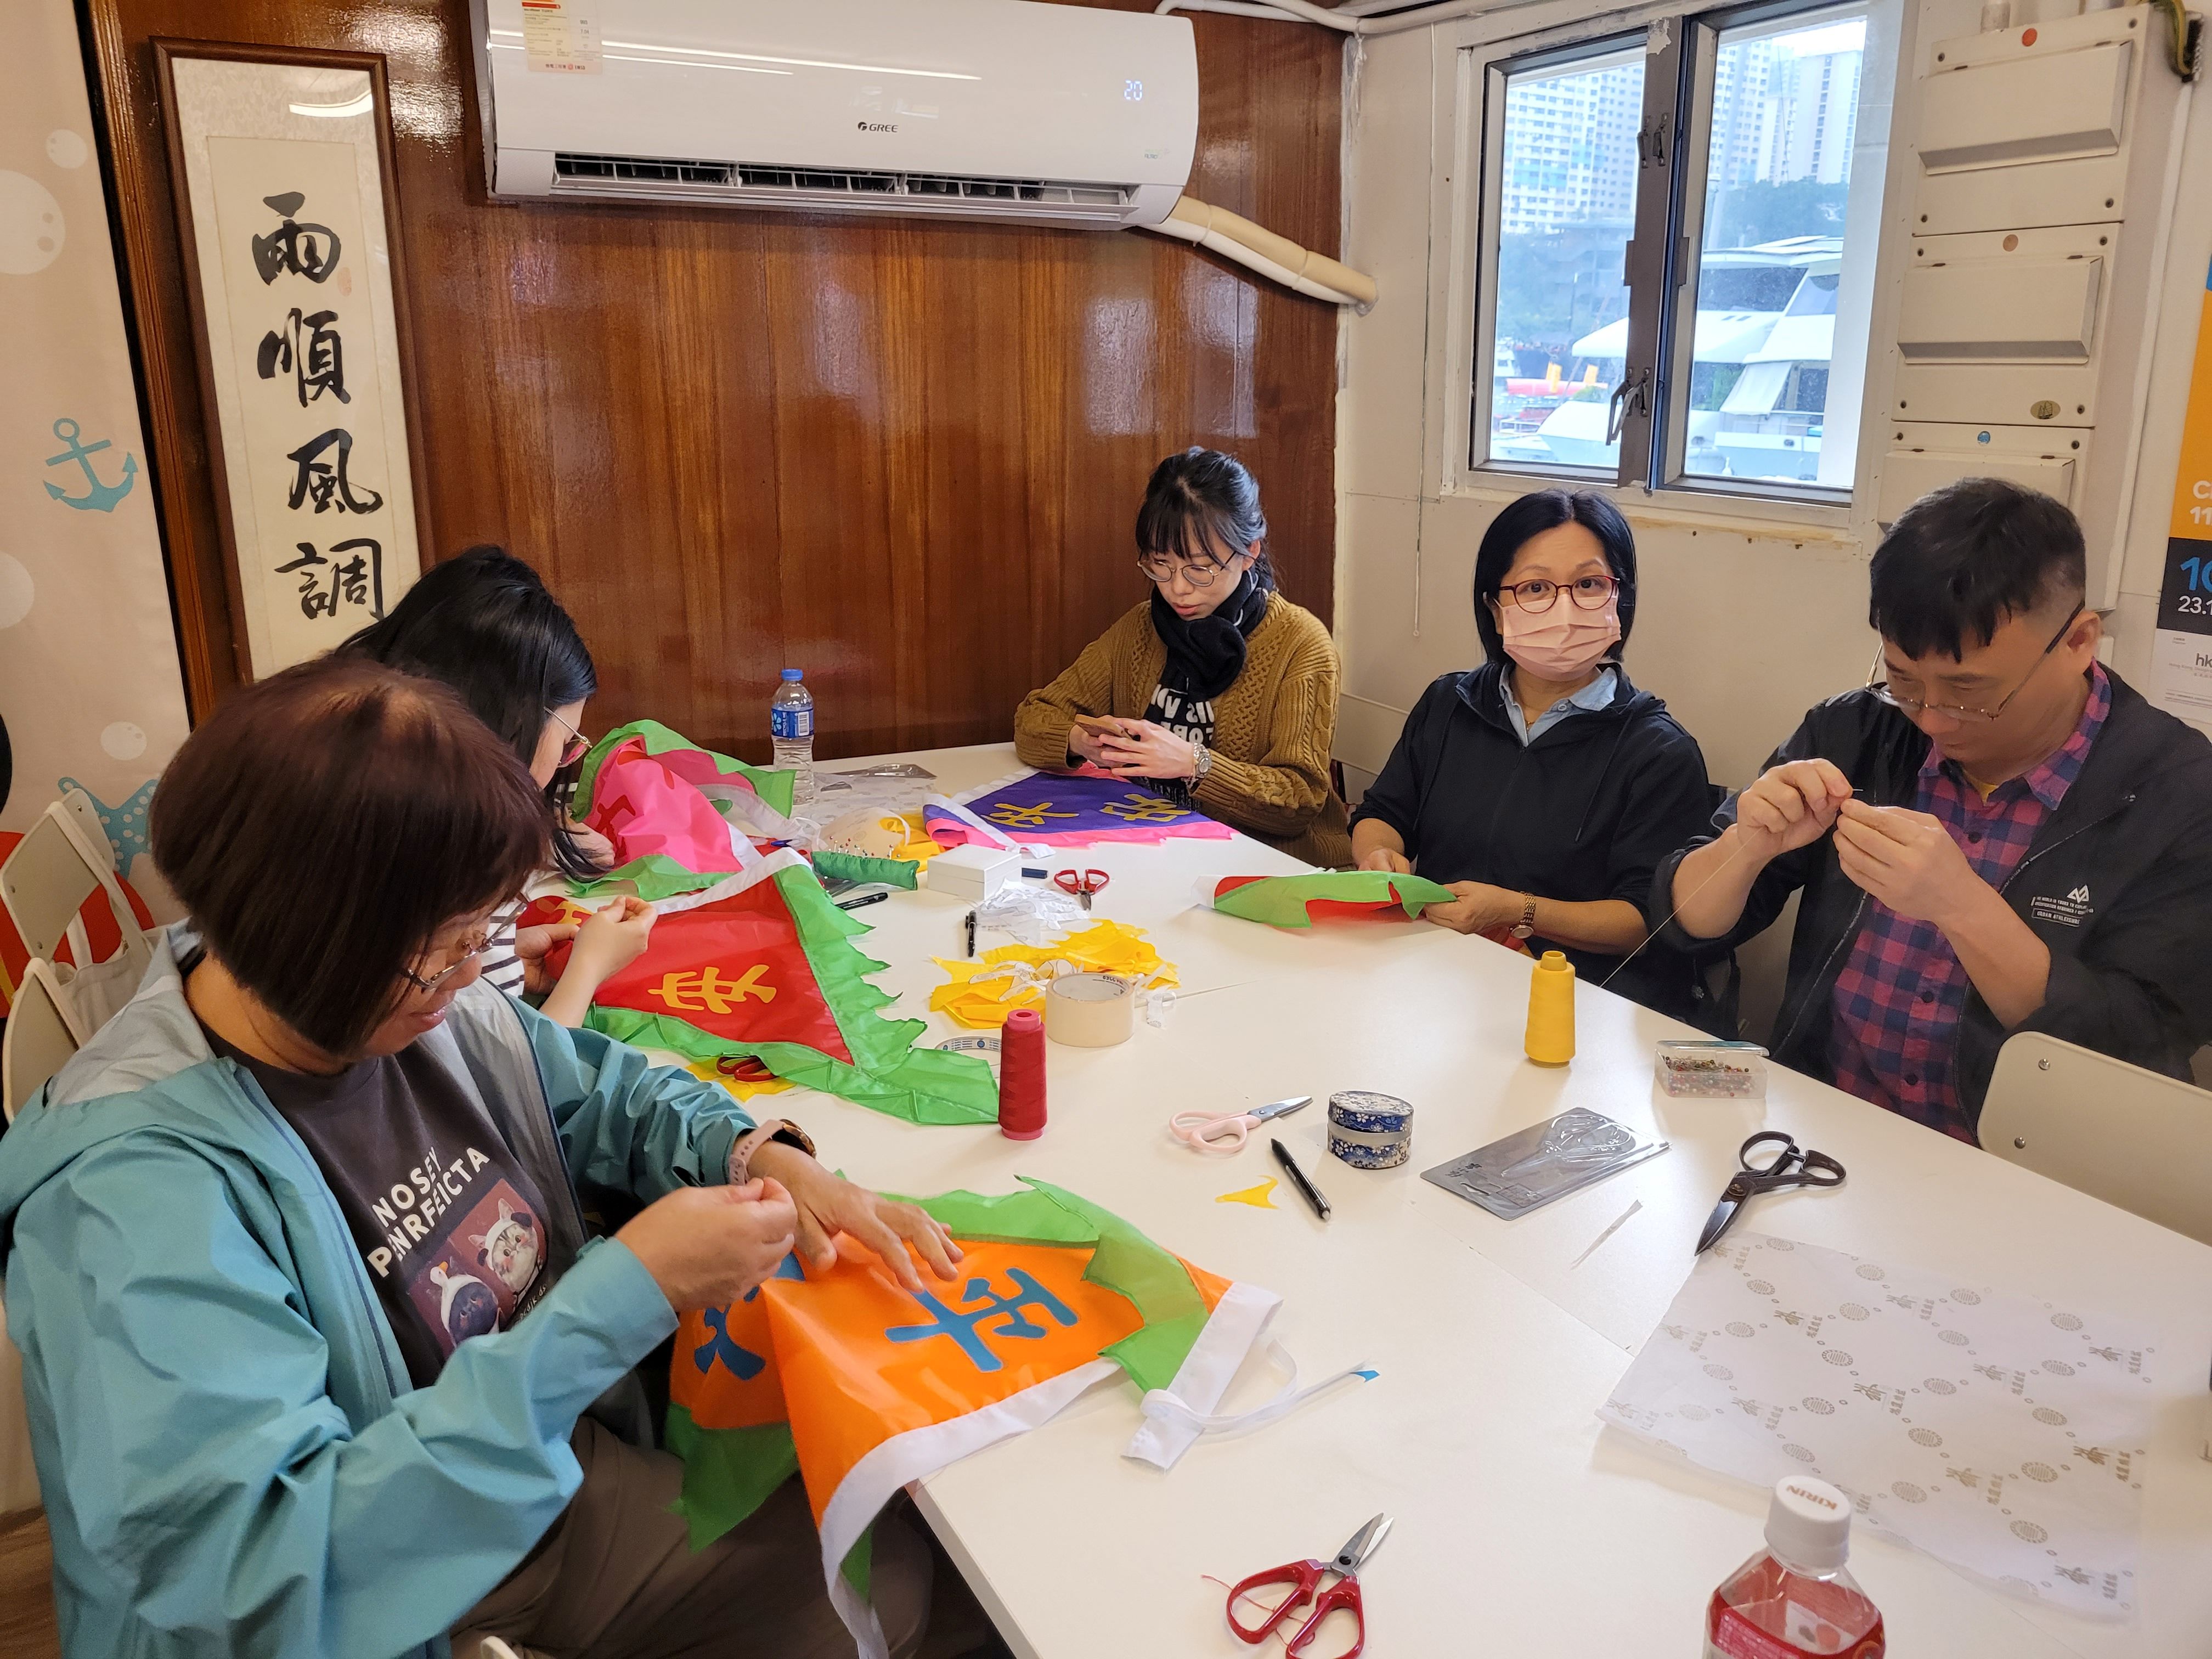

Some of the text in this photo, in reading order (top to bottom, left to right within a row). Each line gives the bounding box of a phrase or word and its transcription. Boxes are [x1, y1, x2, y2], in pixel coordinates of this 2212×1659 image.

[1124, 80, 1143, 101] 20
[869, 123, 899, 133] GREE
[2193, 481, 2212, 499] C
[372, 1146, 441, 1227] NOSEY
[1786, 1485, 1838, 1510] KIRIN
